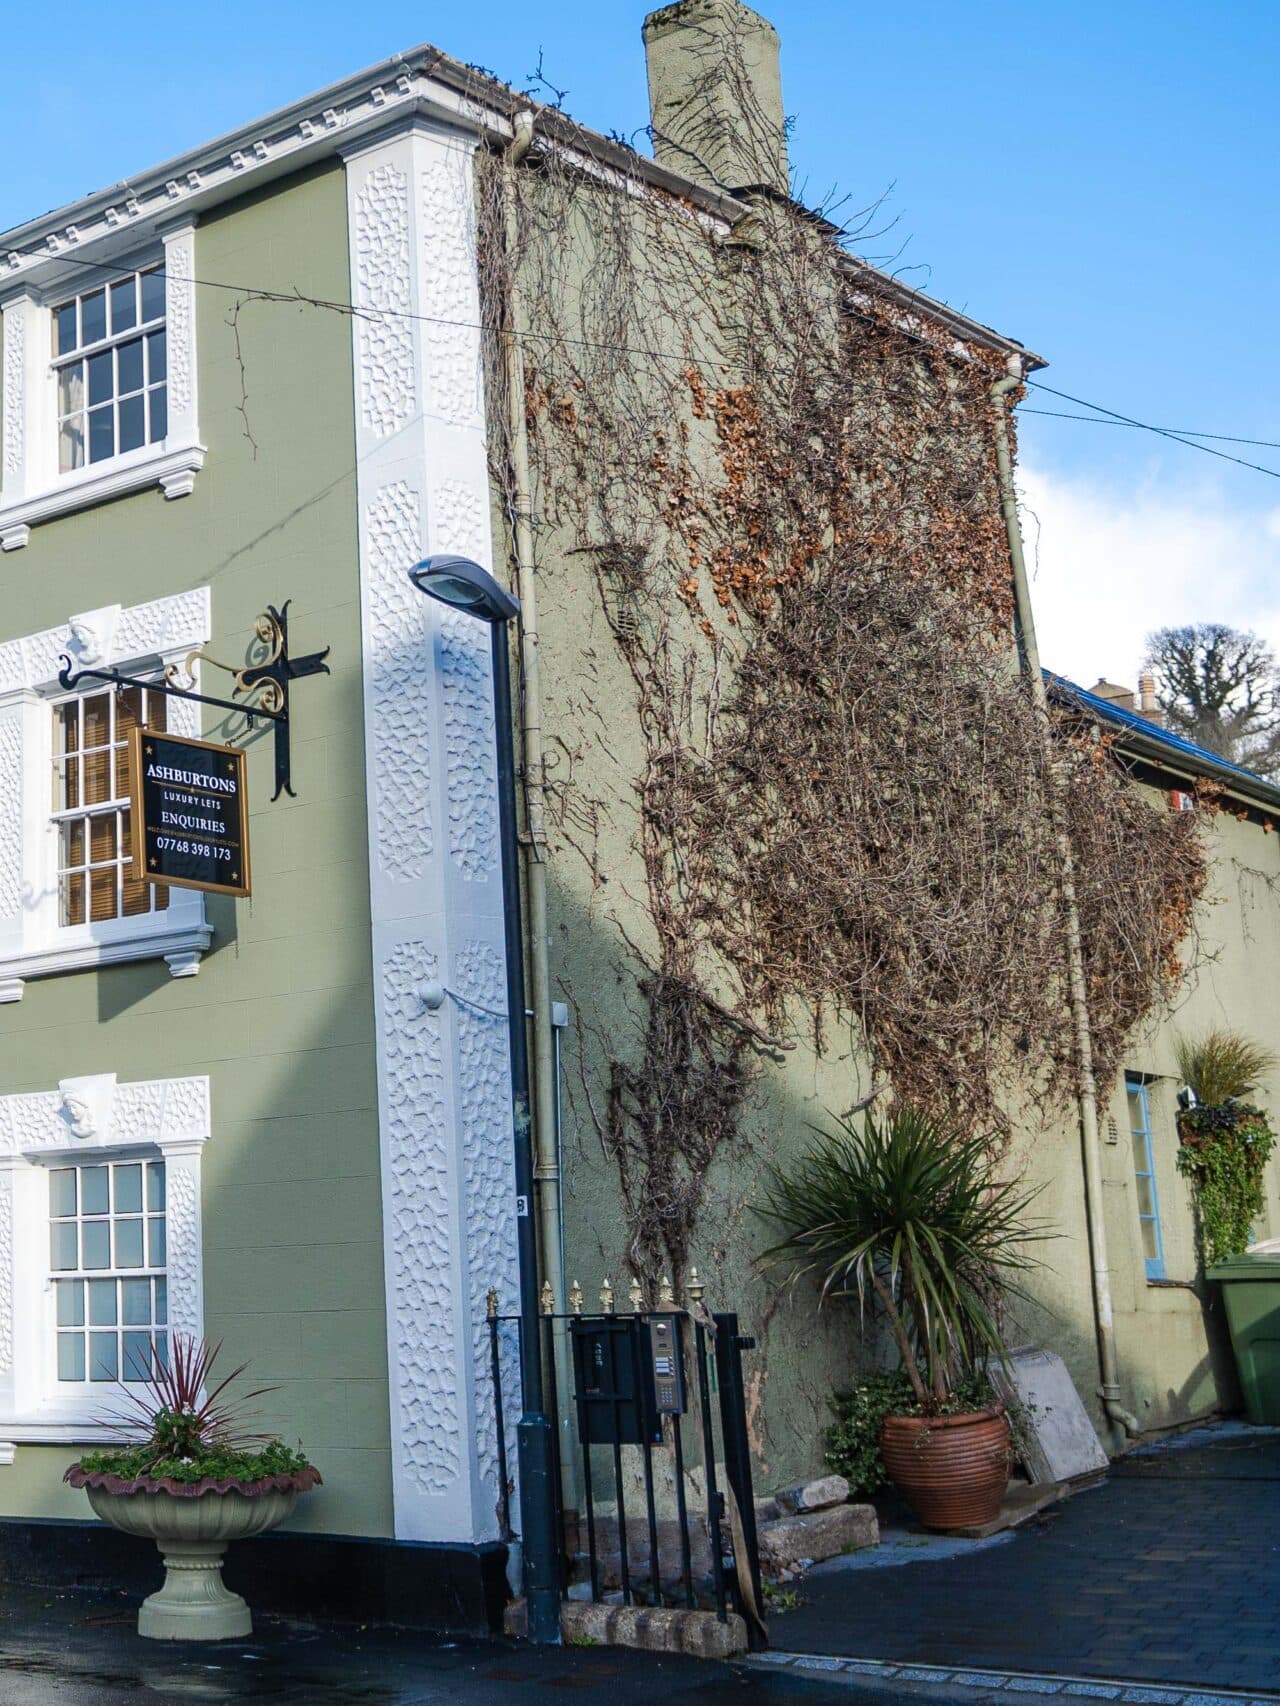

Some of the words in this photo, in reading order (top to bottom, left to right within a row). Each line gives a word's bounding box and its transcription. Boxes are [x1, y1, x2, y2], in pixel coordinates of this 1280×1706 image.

[147, 764, 236, 793] ASHBURTONS
[164, 791, 198, 805] LUXURY
[202, 798, 221, 810] LETS
[162, 811, 225, 833] ENQUIRIES
[157, 837, 189, 853] 07768
[191, 843, 210, 857] 398
[213, 847, 231, 861] 173
